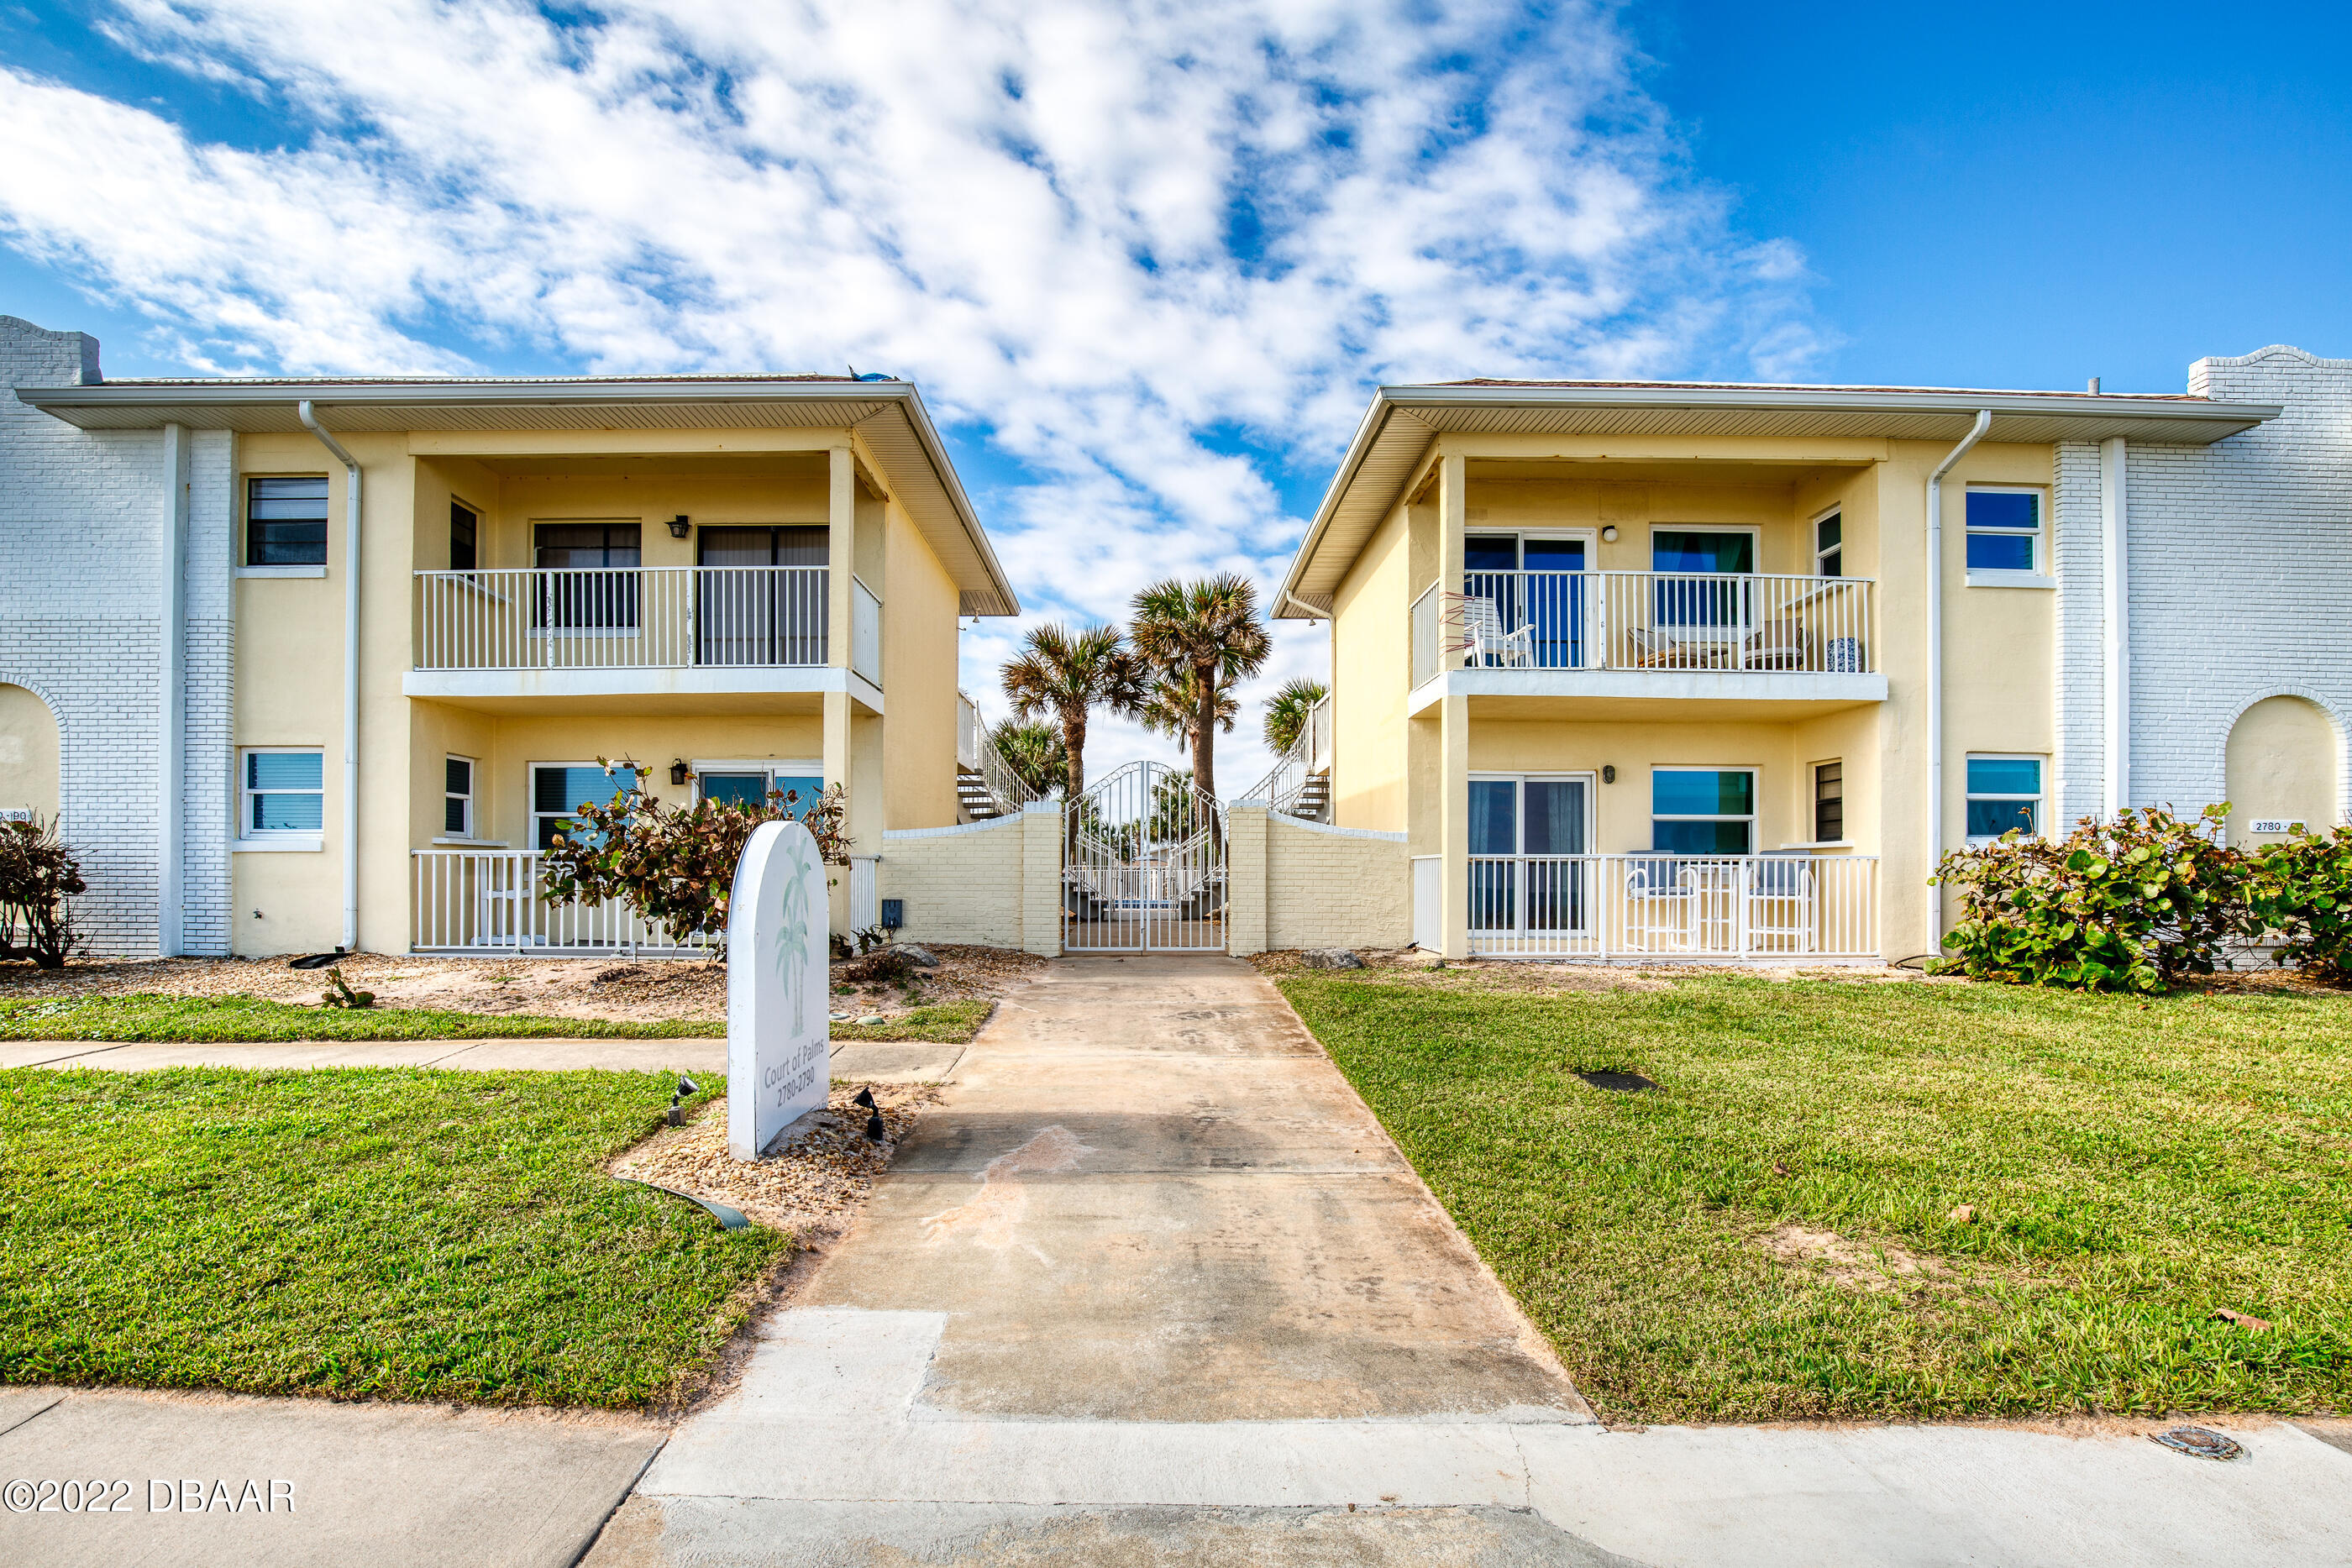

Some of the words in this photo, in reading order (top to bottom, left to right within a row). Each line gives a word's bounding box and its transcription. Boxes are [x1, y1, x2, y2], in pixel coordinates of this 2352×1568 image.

[2256, 822, 2281, 831] 2780
[764, 1056, 790, 1088] Court
[791, 1046, 801, 1071] of
[803, 1038, 824, 1065] Palms
[777, 1066, 815, 1108] 2780-2790
